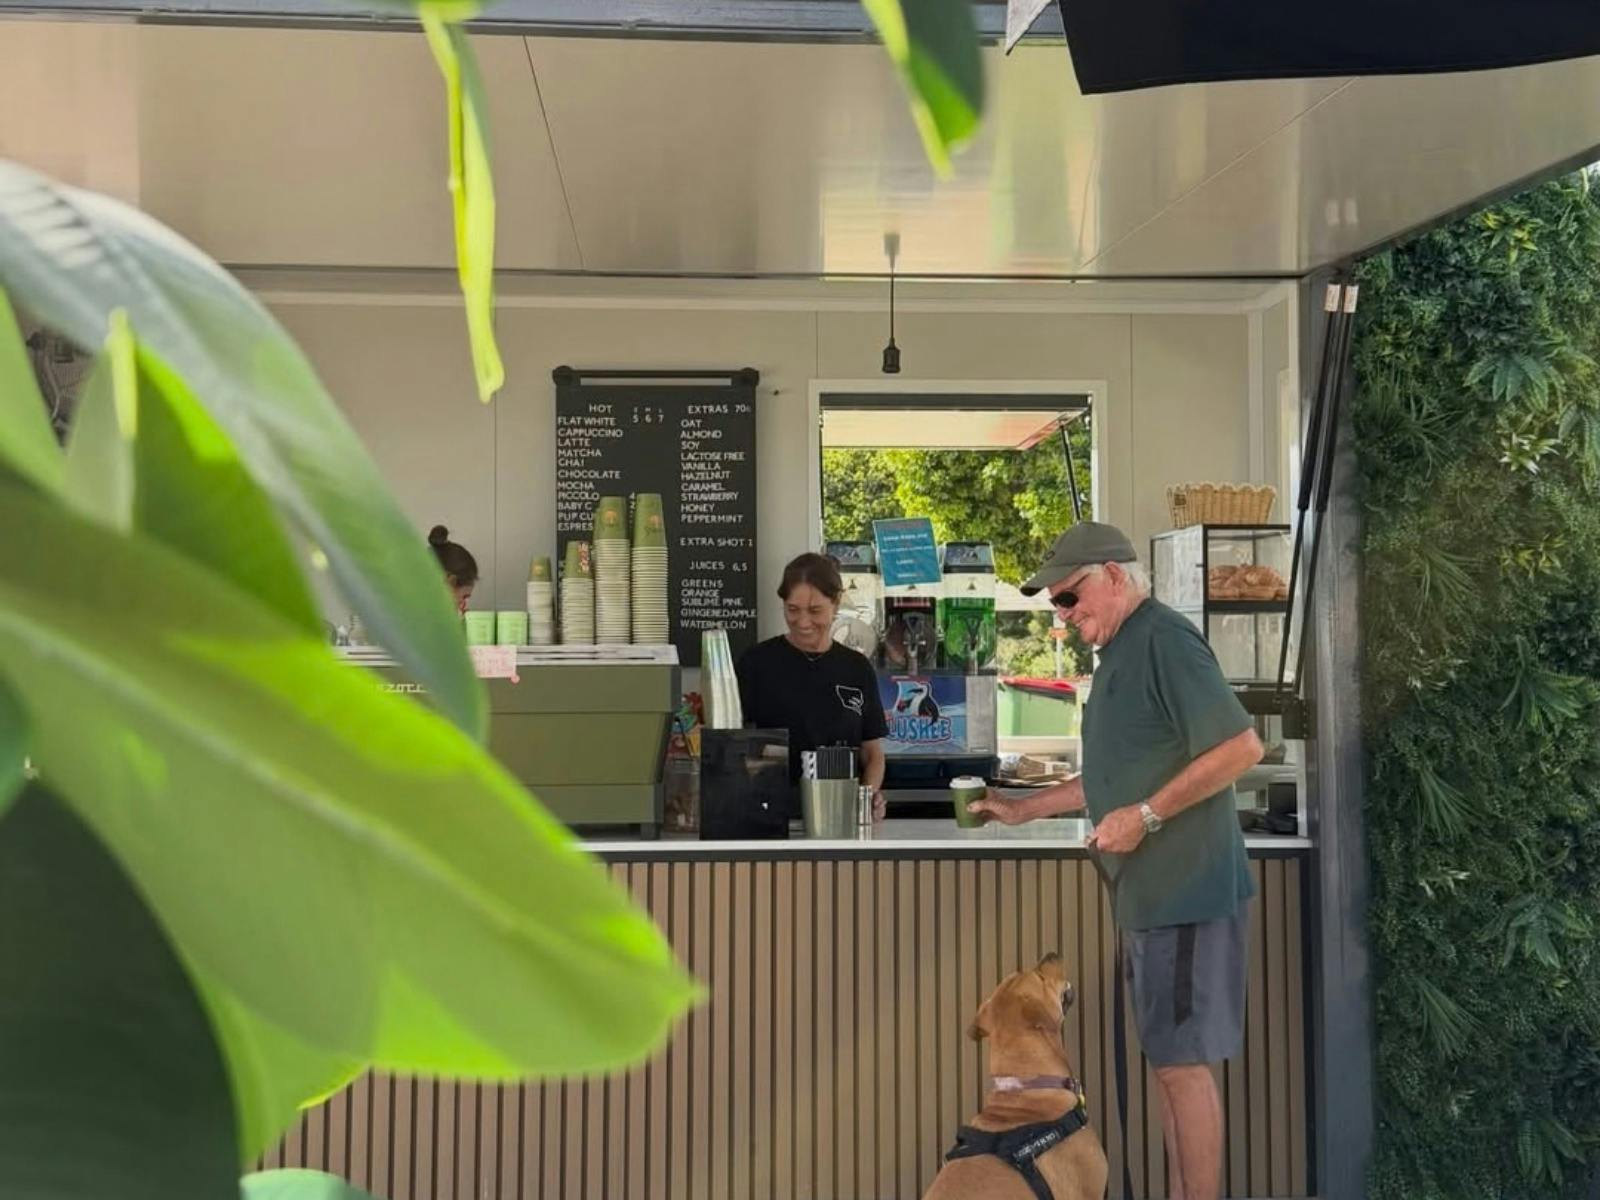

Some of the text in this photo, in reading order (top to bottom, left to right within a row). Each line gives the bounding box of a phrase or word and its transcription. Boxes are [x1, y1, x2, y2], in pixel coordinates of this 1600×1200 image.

[589, 404, 612, 413] HOT
[688, 404, 728, 414] EXTRAS
[558, 416, 616, 426] FLAT WHITE
[681, 419, 702, 428] OAT
[558, 428, 623, 438] CAPPUCCINO
[681, 430, 722, 439] ALMOND
[558, 439, 591, 447] LATTE
[681, 441, 700, 450] SOY
[558, 449, 602, 457] MATCHA
[681, 452, 744, 460] LACTOSE FREE
[558, 459, 585, 467] CHAI
[681, 462, 720, 470] VANILLA
[558, 470, 620, 479] CHOCOLATE
[681, 471, 730, 480] HAZELNUT
[558, 482, 594, 490] MOCHA
[681, 483, 726, 491] CARAMEL
[558, 491, 600, 501] PICCOLO
[681, 492, 739, 501] STRAWBERRY
[558, 502, 582, 510] BABY
[681, 504, 715, 512] HONEY
[558, 512, 593, 520] PUP CU
[681, 514, 743, 523] PEPPERMINT
[558, 523, 593, 531] ESPRES
[680, 538, 714, 546] EXTRA
[717, 538, 744, 547] SHOT
[690, 561, 725, 570] JUICES
[681, 579, 724, 588] GREENS
[681, 589, 720, 598] ORANGE
[681, 598, 743, 606] SUBLIME PINE
[680, 619, 746, 629] WATERMELON
[884, 717, 949, 740] LUSHEE
